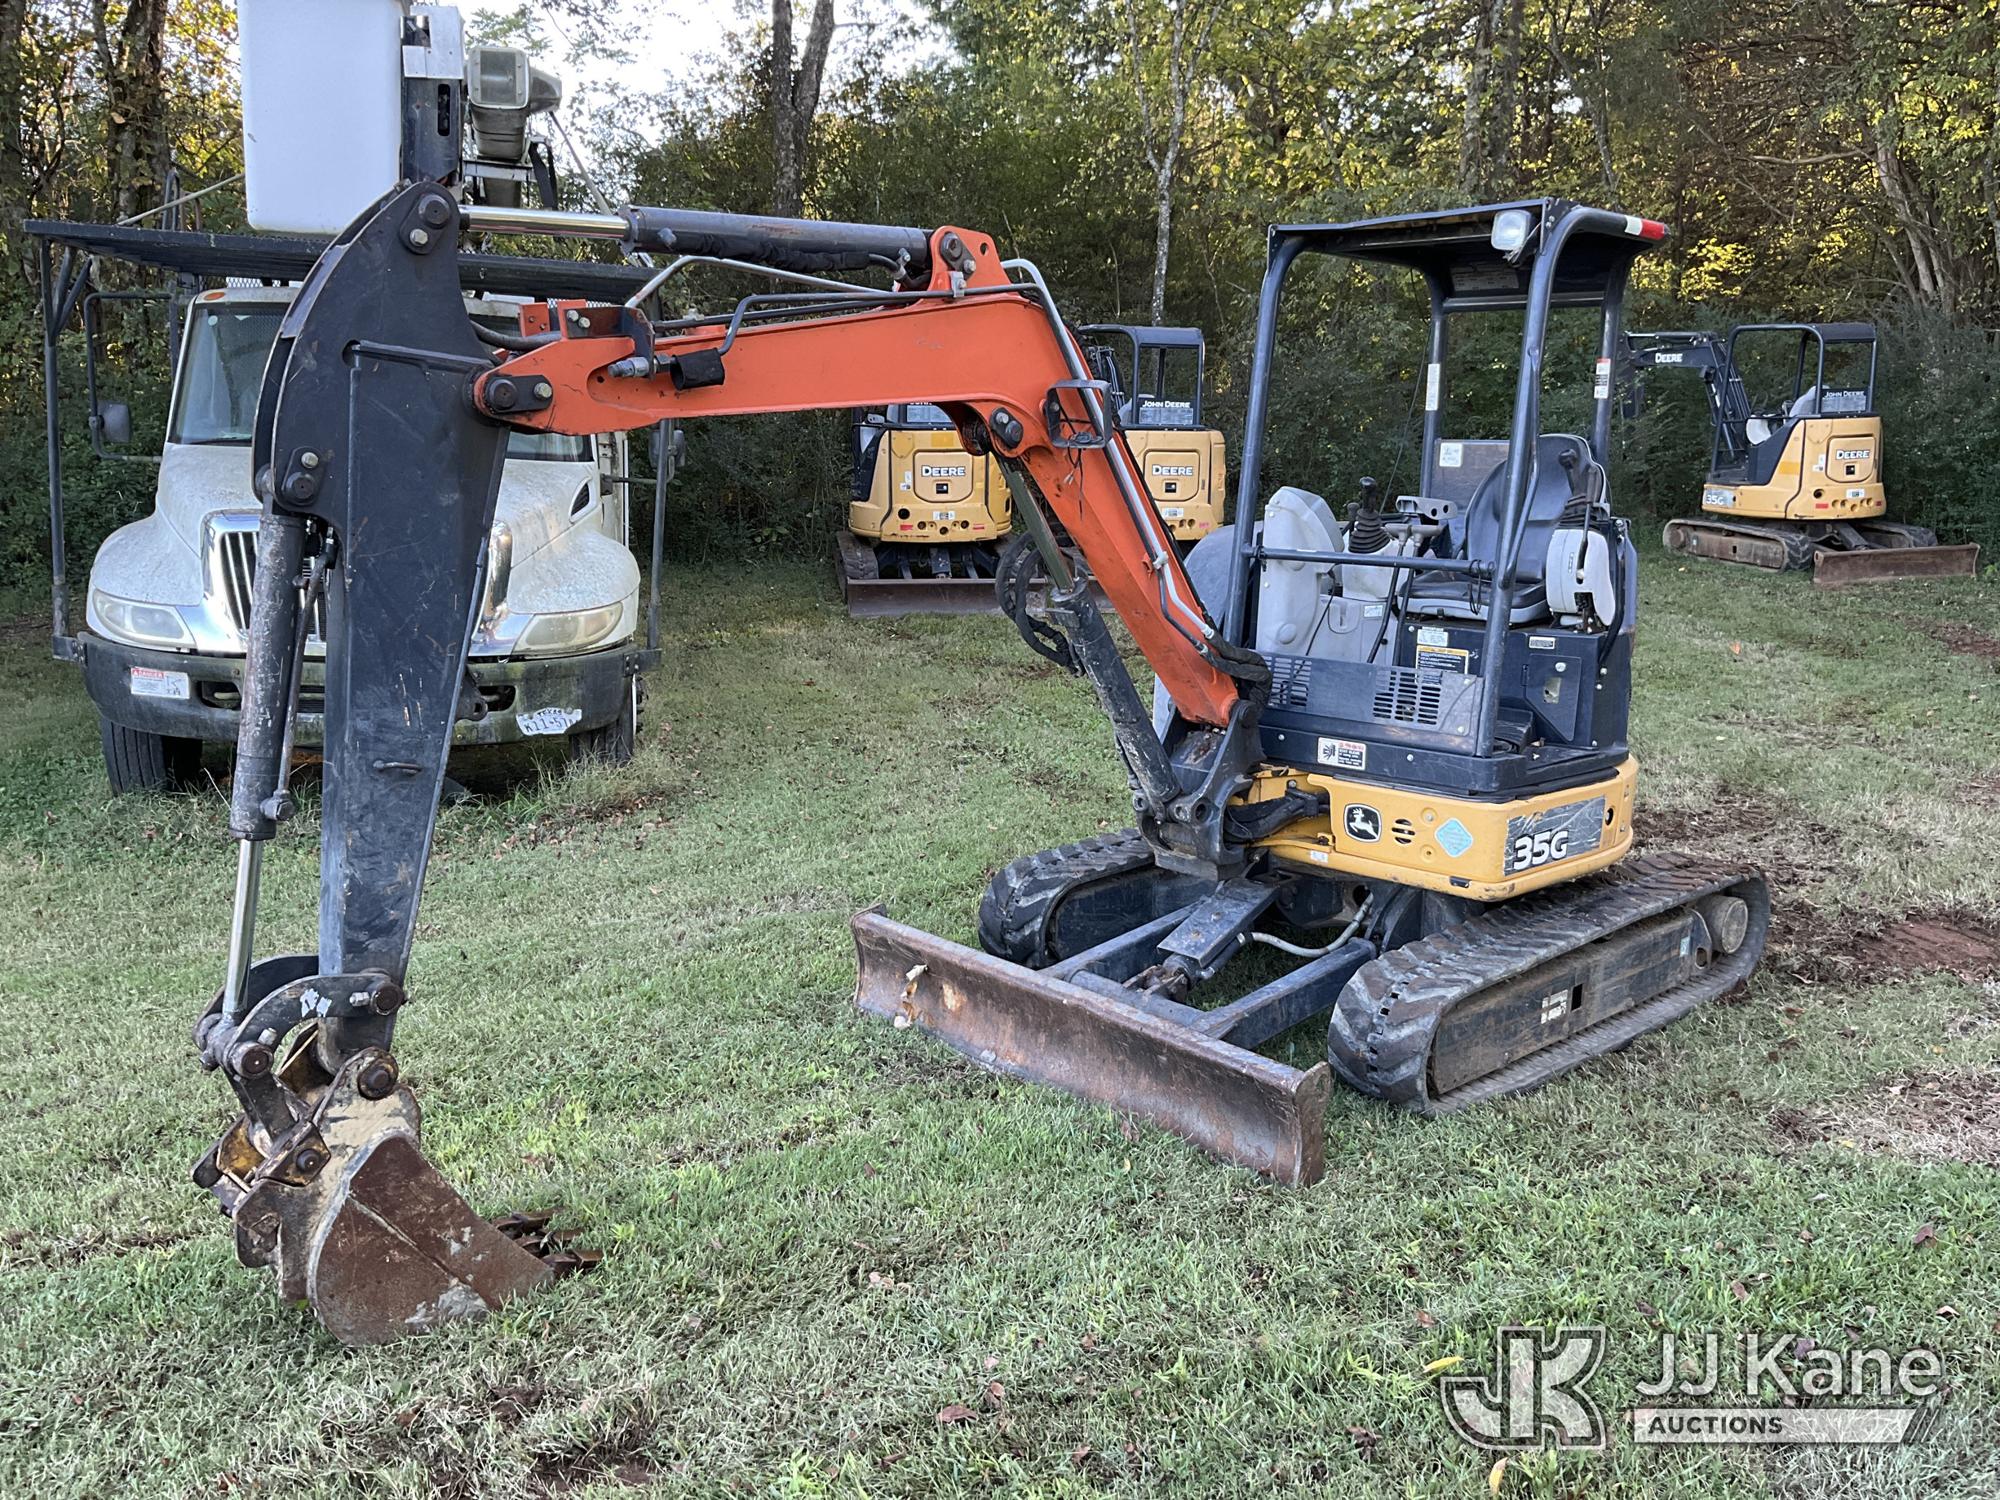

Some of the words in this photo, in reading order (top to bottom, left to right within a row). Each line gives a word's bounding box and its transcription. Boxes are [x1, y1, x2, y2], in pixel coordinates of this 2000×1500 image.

[1655, 353, 1683, 363] DEERE
[1142, 400, 1163, 408] JOHN
[1164, 400, 1190, 408] DEERE
[1836, 450, 1870, 460] DEERE
[921, 465, 966, 477] DEERE
[1152, 464, 1193, 476] DEERE
[1513, 829, 1569, 870] 35G
